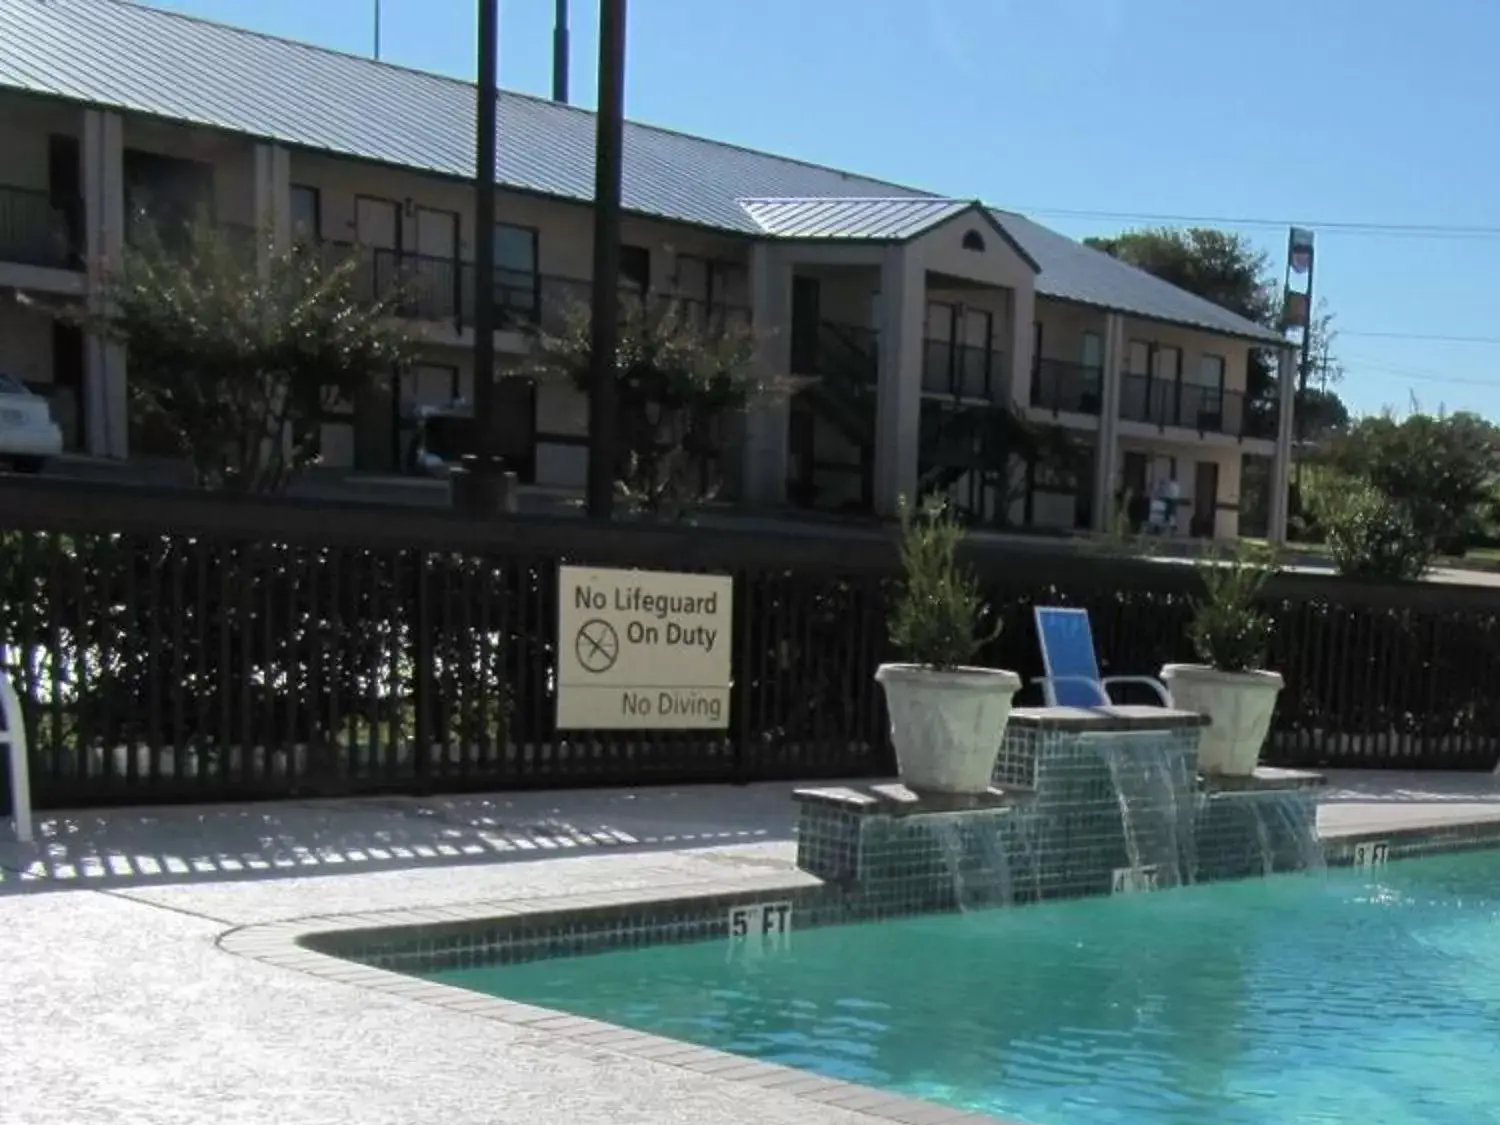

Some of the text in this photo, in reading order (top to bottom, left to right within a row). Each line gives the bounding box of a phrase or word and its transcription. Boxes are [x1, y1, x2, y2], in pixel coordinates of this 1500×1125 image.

[575, 585, 718, 619] No Lifeguard
[627, 621, 717, 652] On Duty
[622, 692, 721, 721] No Diving
[732, 905, 790, 937] 5 FT
